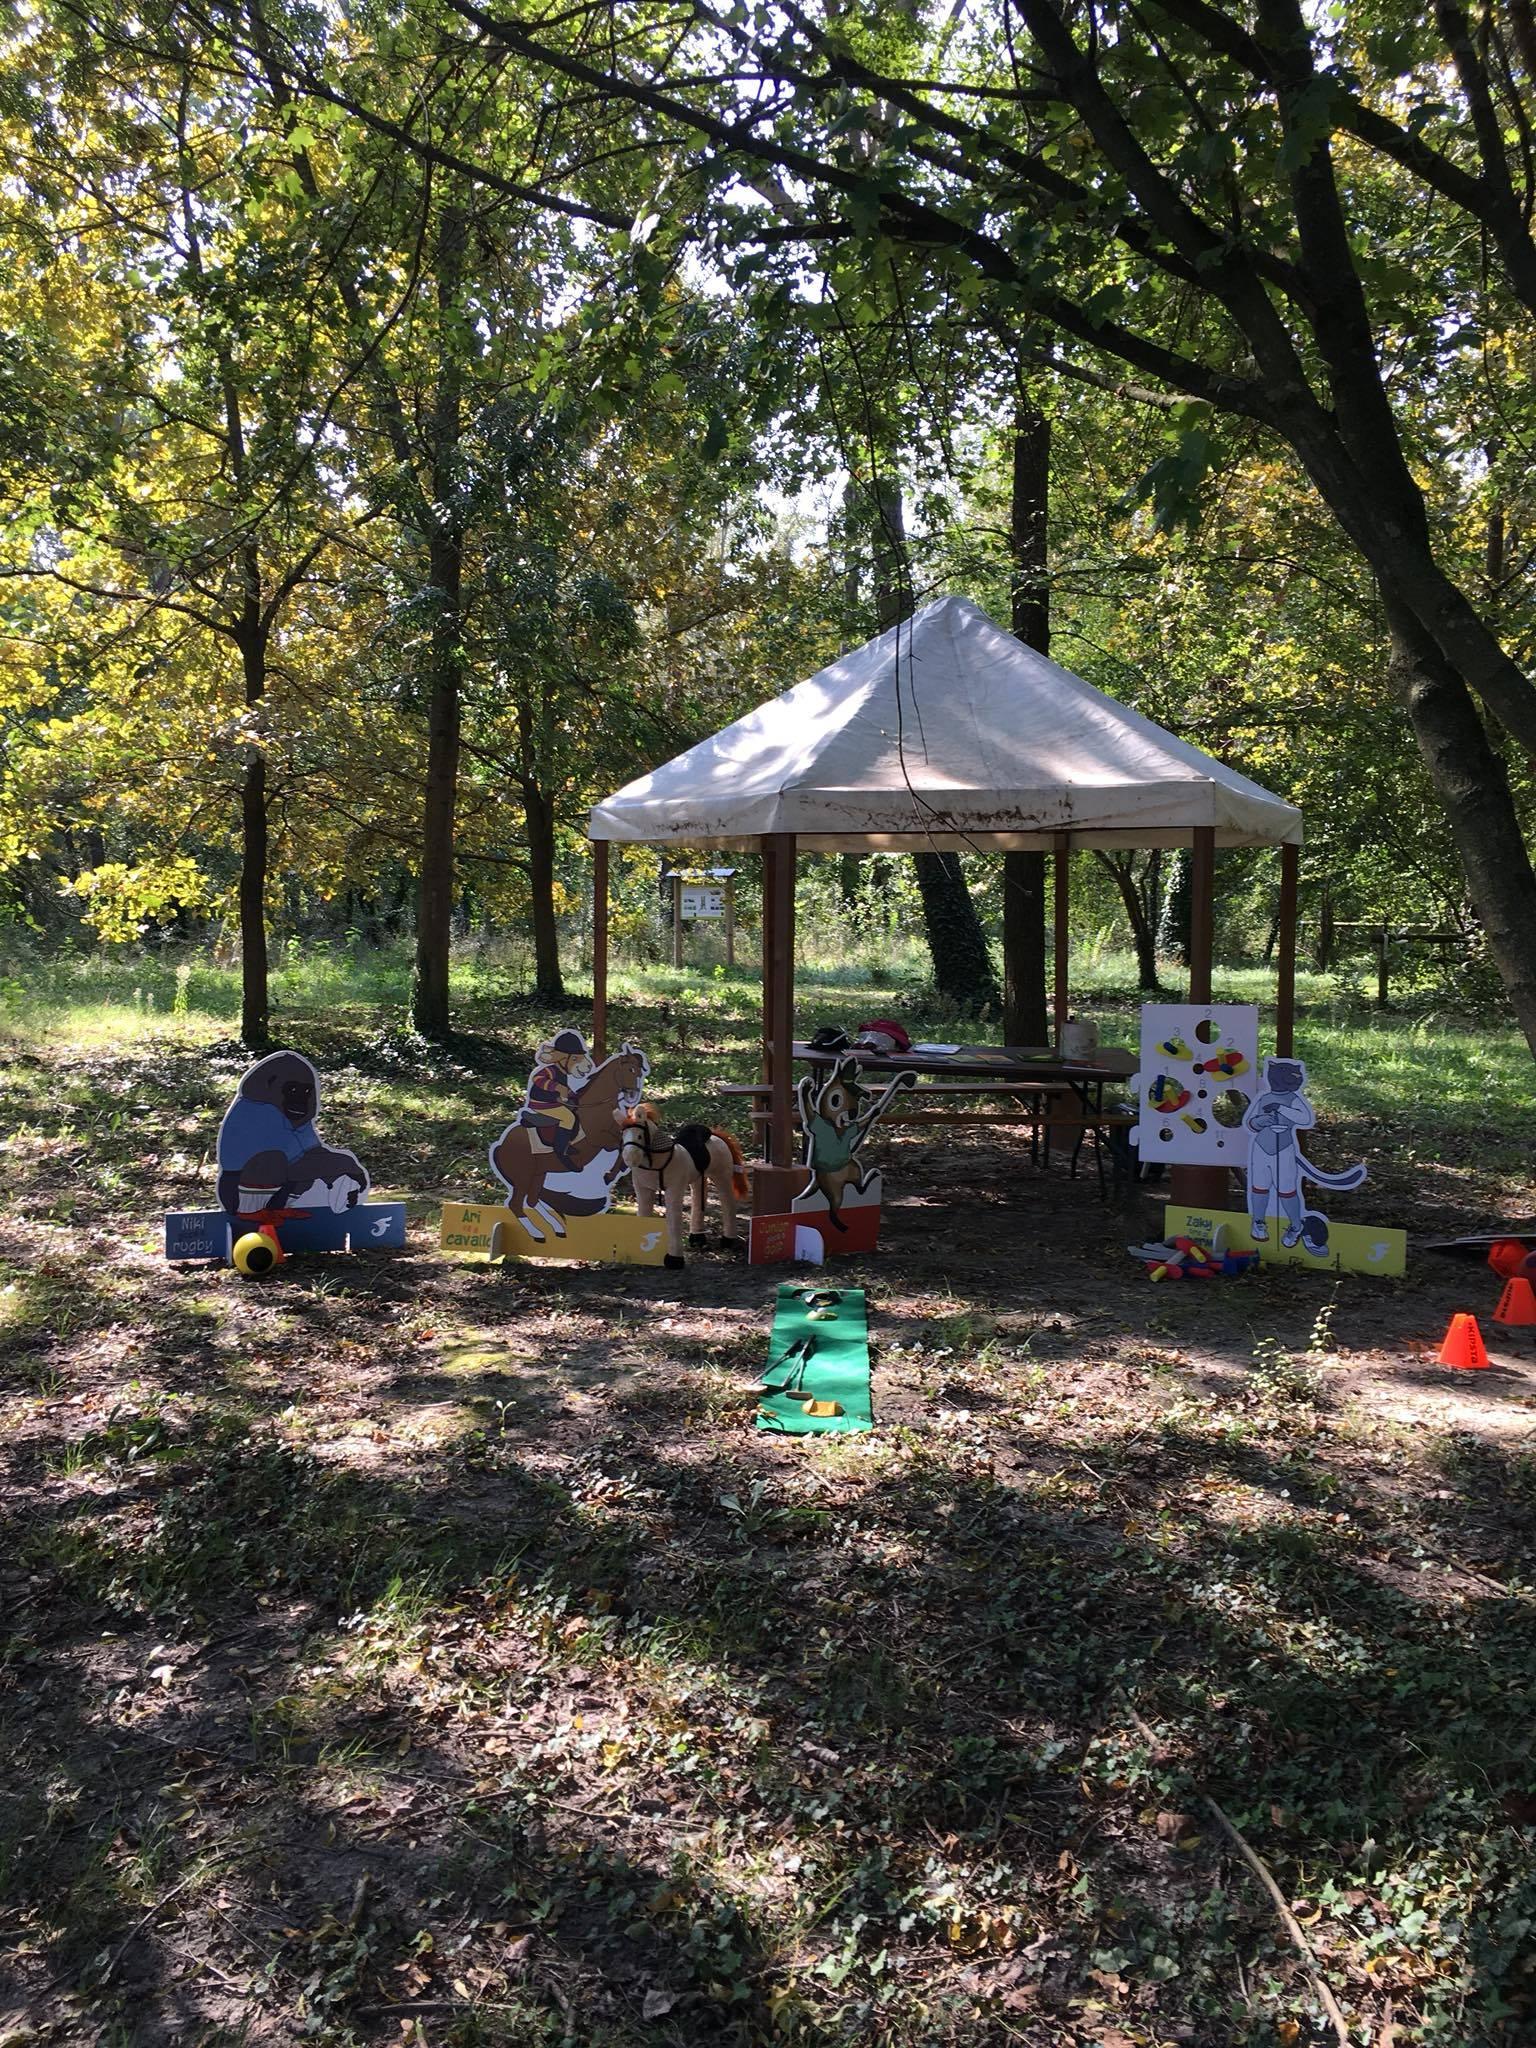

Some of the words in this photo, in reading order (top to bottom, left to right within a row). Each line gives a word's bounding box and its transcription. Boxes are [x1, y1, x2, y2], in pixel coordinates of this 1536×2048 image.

[181, 1216, 205, 1230] Niki
[1186, 1215, 1213, 1231] Zaky
[172, 1239, 213, 1254] rugby
